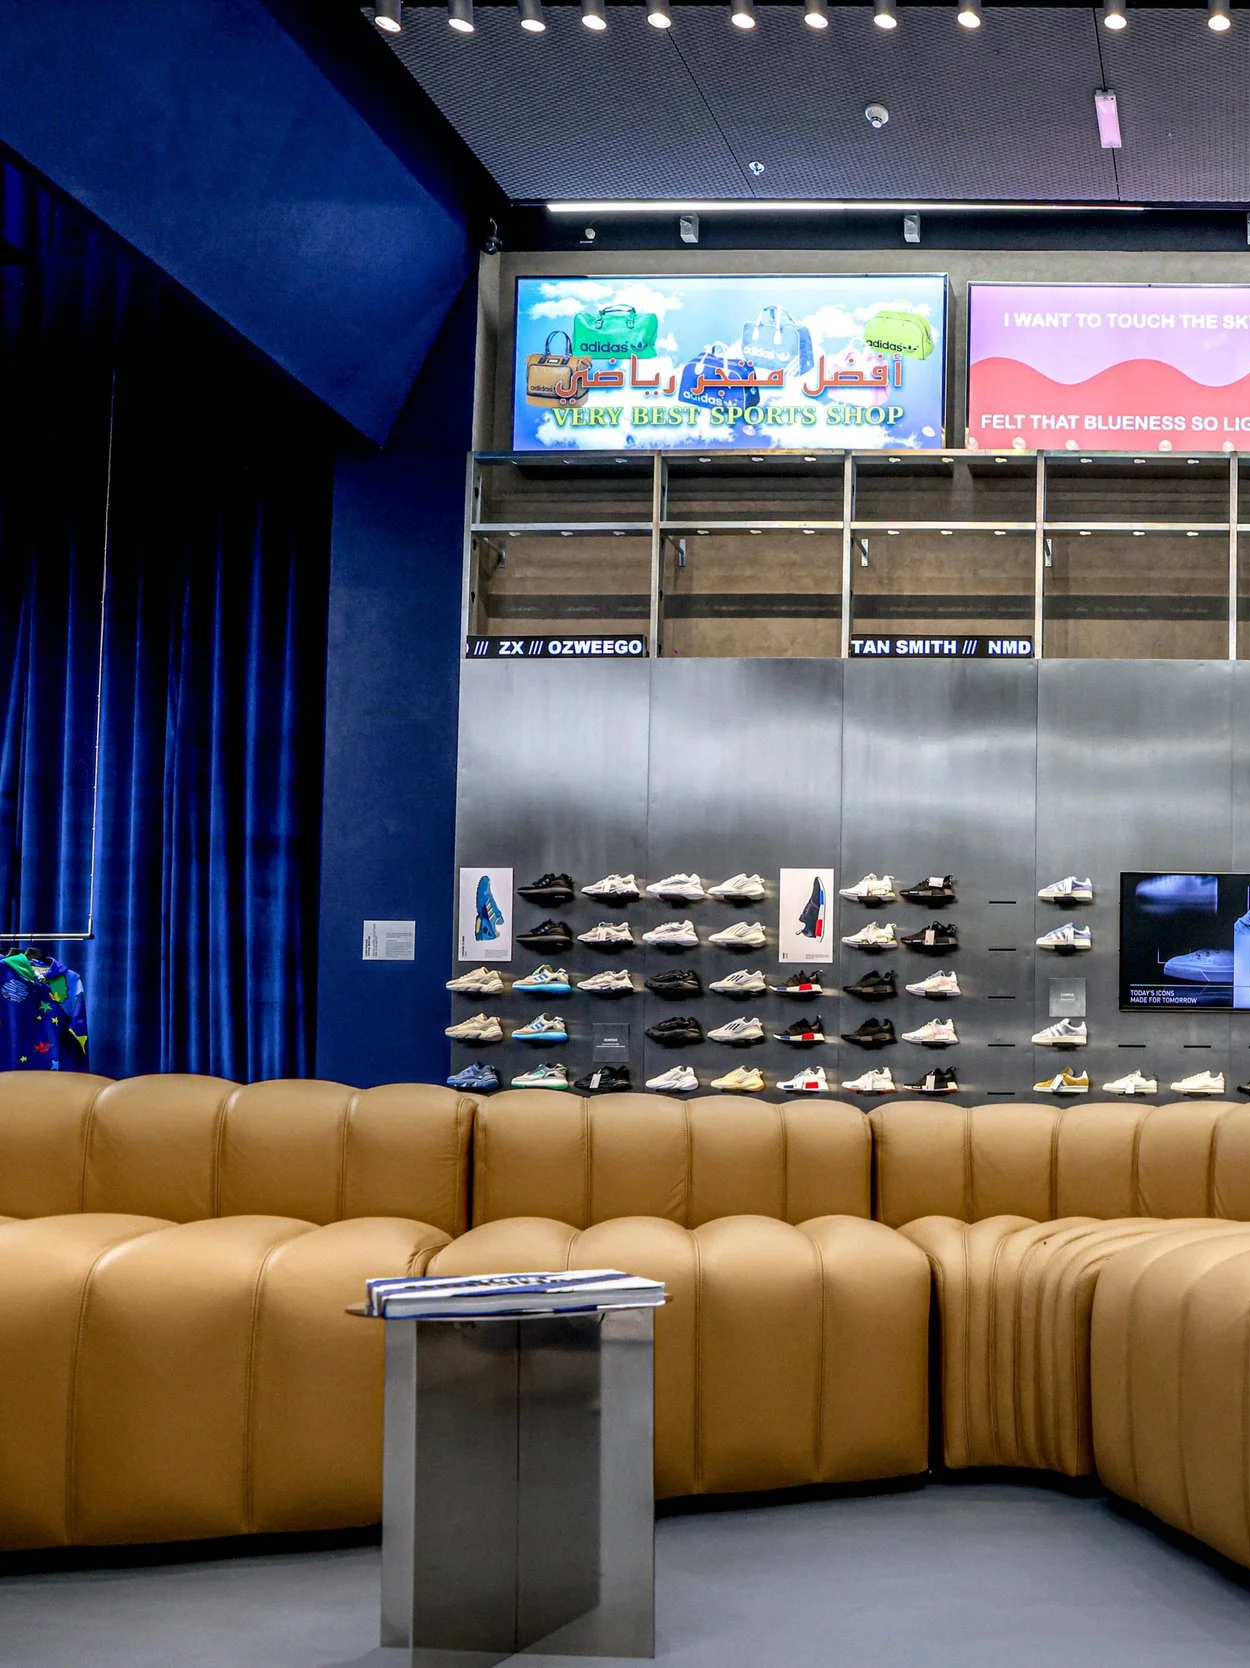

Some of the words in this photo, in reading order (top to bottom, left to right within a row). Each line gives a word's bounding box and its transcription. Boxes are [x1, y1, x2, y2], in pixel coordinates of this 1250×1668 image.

[1004, 313, 1009, 328] I
[1014, 313, 1070, 328] WANT
[1076, 313, 1102, 328] TO
[1106, 313, 1175, 328] TOUCH
[1180, 314, 1217, 329] THE
[580, 341, 628, 353] adidas
[866, 339, 903, 352] adidas
[555, 353, 675, 405] رياضي
[690, 360, 784, 396] متجر
[803, 353, 902, 396] أفضل
[530, 385, 553, 393] adidas
[552, 406, 623, 426] VERY
[632, 406, 700, 425] BEST
[710, 406, 818, 425] SPORTS
[827, 406, 904, 425] SHOP
[981, 415, 1026, 430] FELT
[1030, 415, 1080, 430] THAT
[1085, 415, 1186, 431] BLUENESS
[1191, 416, 1218, 431] SO
[498, 641, 524, 655] ZX
[548, 640, 642, 654] OZWEEGO
[895, 640, 957, 654] SMITH
[988, 640, 1032, 654] NMD
